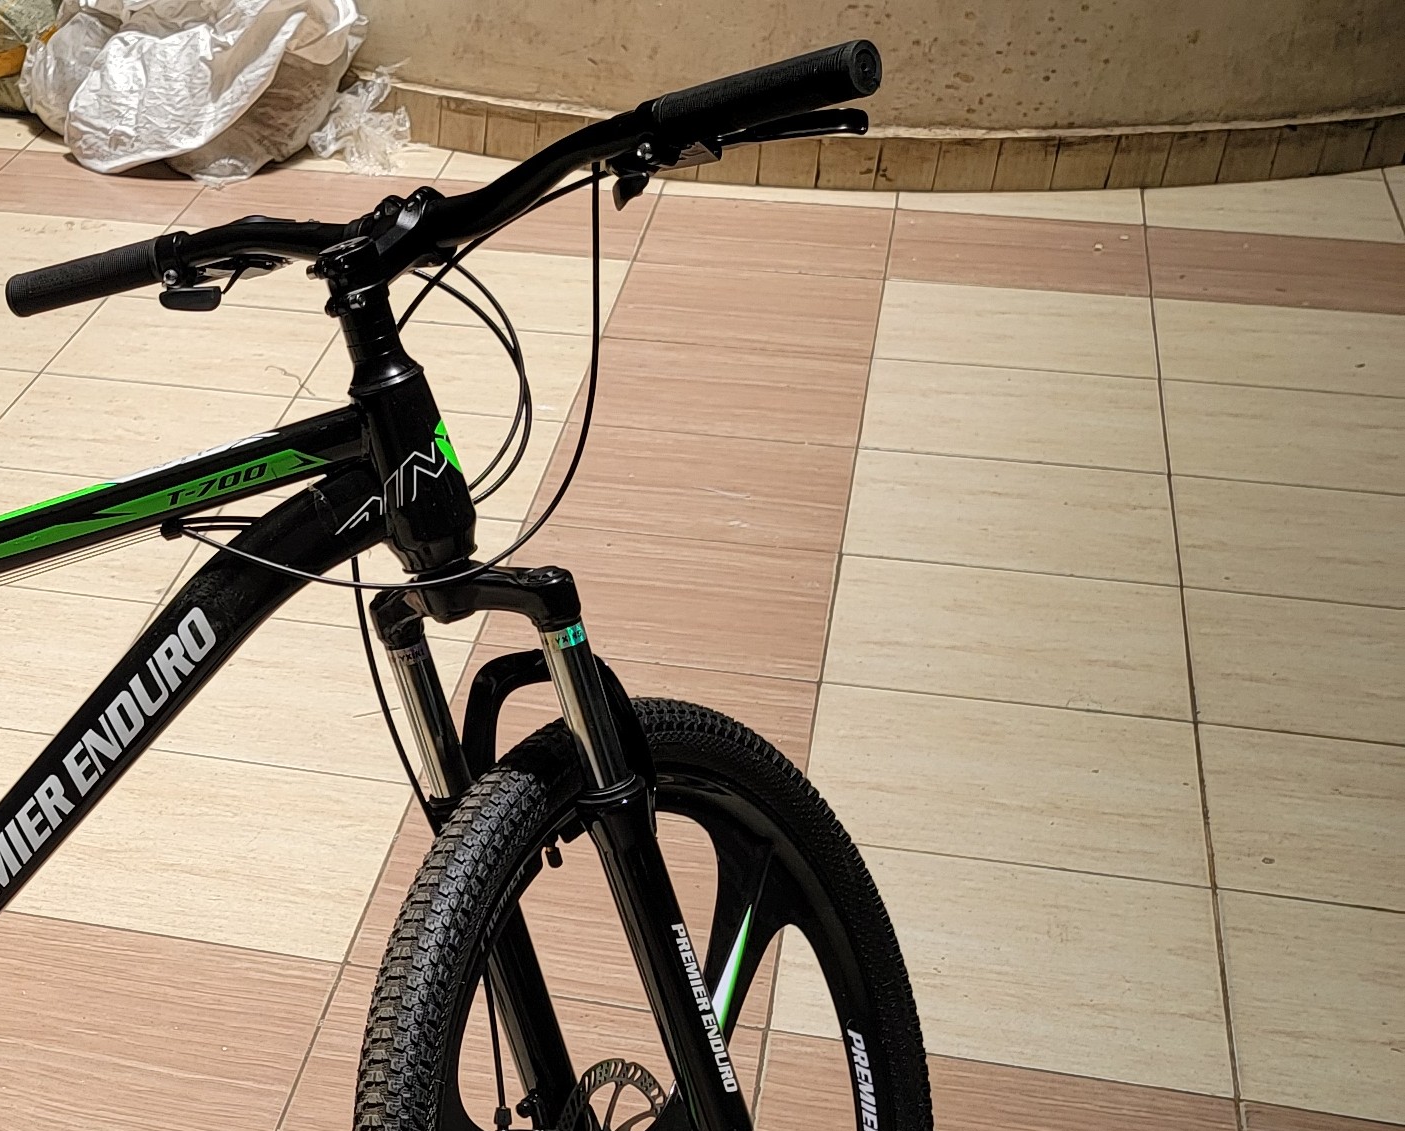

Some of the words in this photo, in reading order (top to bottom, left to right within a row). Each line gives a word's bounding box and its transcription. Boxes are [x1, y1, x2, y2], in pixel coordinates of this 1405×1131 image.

[167, 462, 268, 507] T-700
[62, 606, 217, 798] ENDURO
[671, 922, 711, 1012] PREMIER
[700, 1013, 738, 1093] ENDURO
